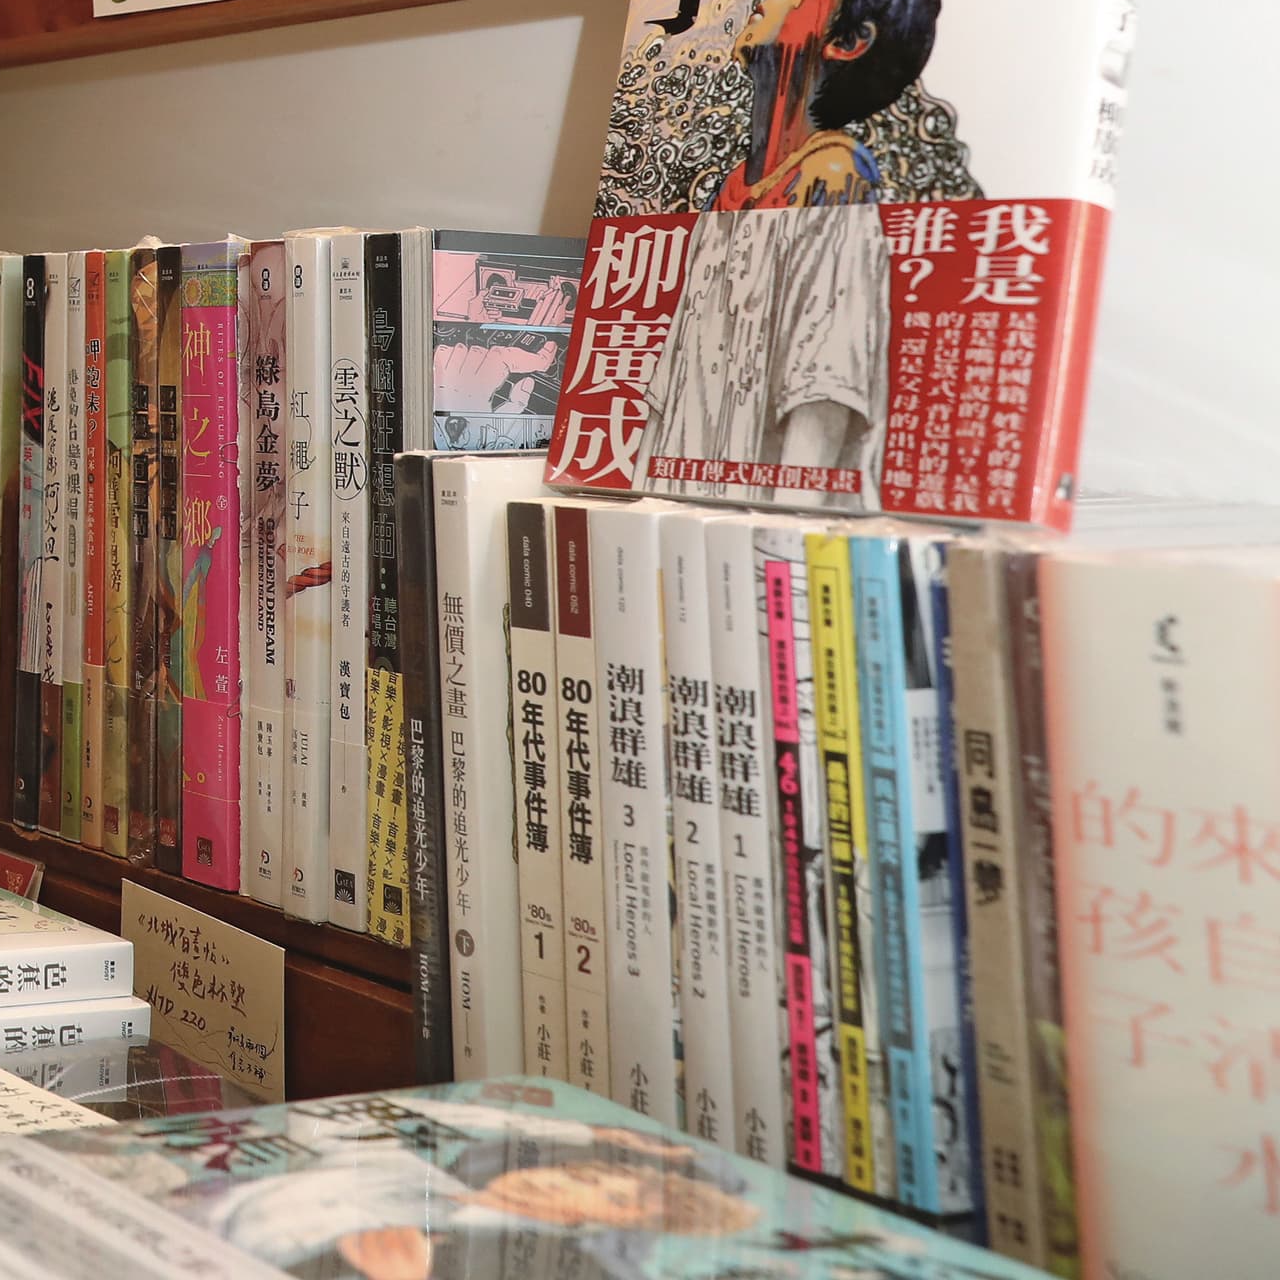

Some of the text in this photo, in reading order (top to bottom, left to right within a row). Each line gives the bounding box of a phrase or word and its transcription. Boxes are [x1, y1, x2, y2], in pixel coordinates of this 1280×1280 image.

[550, 223, 690, 484] 柳廣成
[182, 321, 213, 549] 神之鄉
[254, 354, 281, 494] 綠島金夢
[289, 387, 316, 521] 紅繩子
[333, 366, 367, 493] 雲之獸
[371, 307, 396, 560] 島嶼狂想曲
[651, 457, 859, 494] 類自傳式原創漫畫
[256, 583, 265, 632] ISLAND
[265, 517, 276, 666] GOLDEN DREAM
[340, 510, 353, 628] 來自遠古的守護者
[521, 535, 530, 558] data
[522, 558, 531, 587] comic
[214, 645, 231, 696] 左萱
[368, 594, 382, 648] 在唱歌
[383, 596, 398, 651] 聽台灣
[441, 591, 467, 719] 無價之畫
[338, 659, 352, 721] 漢寶包
[607, 662, 648, 792] 潮浪群雄
[669, 674, 713, 806] 潮浪群雄
[714, 683, 762, 819] 潮浪群雄
[409, 717, 430, 901] 巴黎的追光少年
[450, 731, 472, 917] 巴黎的追光少年
[516, 670, 549, 855] 80年代事件簿
[560, 677, 595, 866] 80年代事件簿
[623, 841, 637, 890] Local
[624, 891, 639, 961] Heroes
[687, 859, 701, 905] Local
[1068, 777, 1195, 1071] 的孩子
[533, 931, 545, 960] 1
[576, 945, 592, 976] 2
[689, 910, 704, 981] Heroes
[734, 873, 752, 999] Local Heroes
